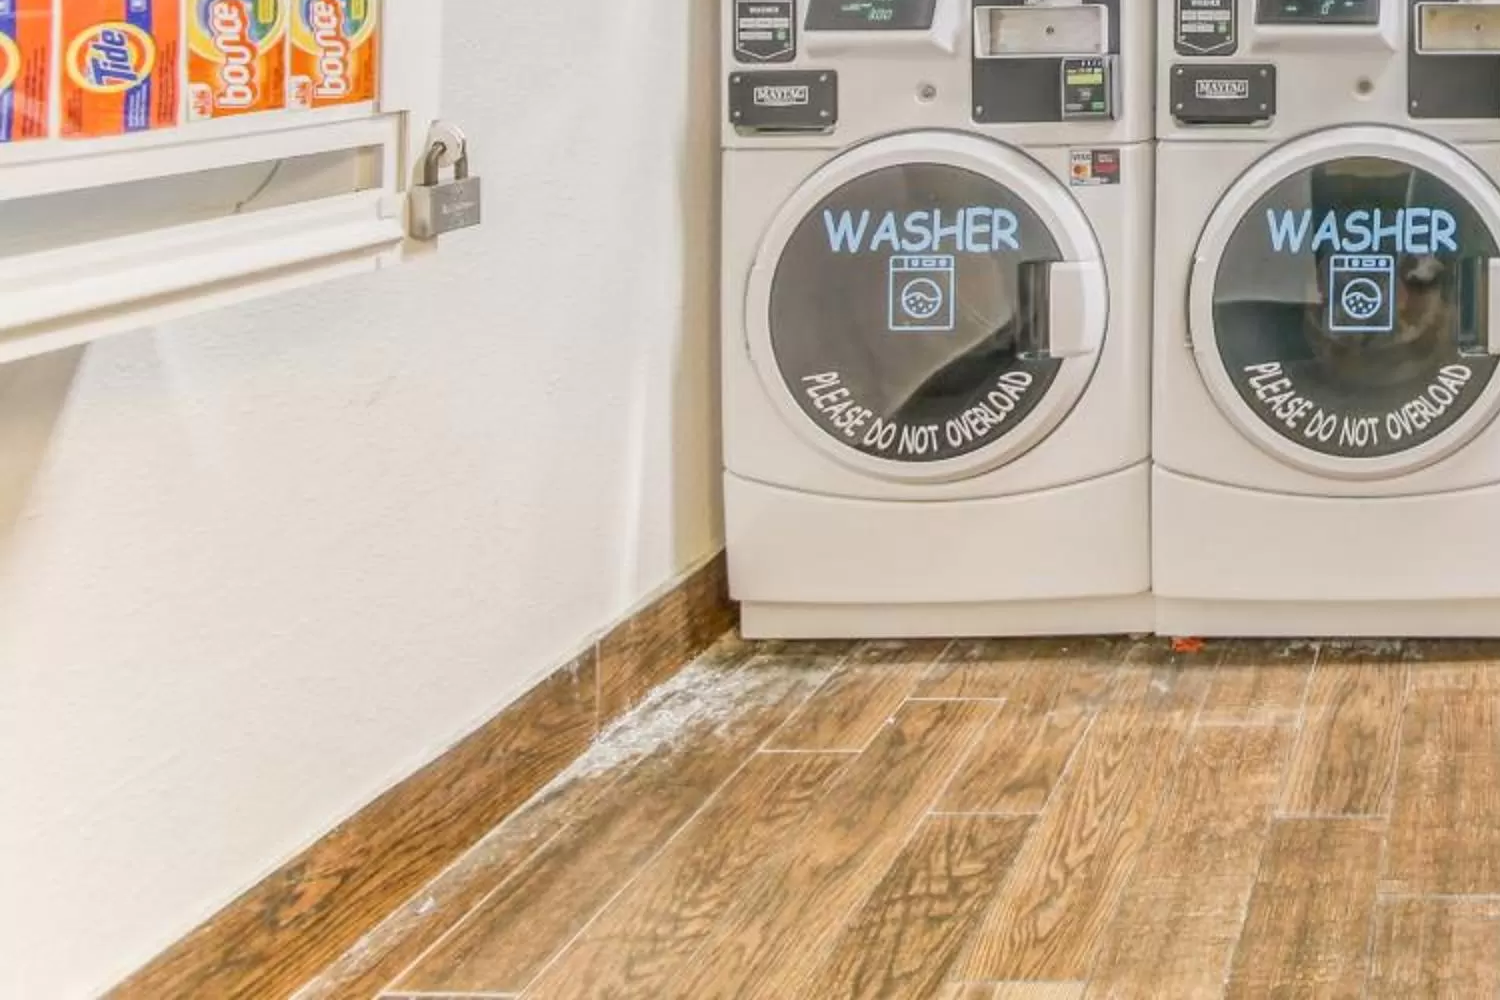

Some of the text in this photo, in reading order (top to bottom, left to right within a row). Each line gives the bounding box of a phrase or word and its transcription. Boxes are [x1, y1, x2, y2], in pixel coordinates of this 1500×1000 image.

[90, 28, 139, 87] Tide
[823, 204, 1021, 254] WASHER
[1266, 206, 1458, 255] WASHER
[801, 369, 1034, 455] PLEASE DO NOT OVERLOAD
[1243, 360, 1473, 447] PLEASE DO NOT OVERLOAD
